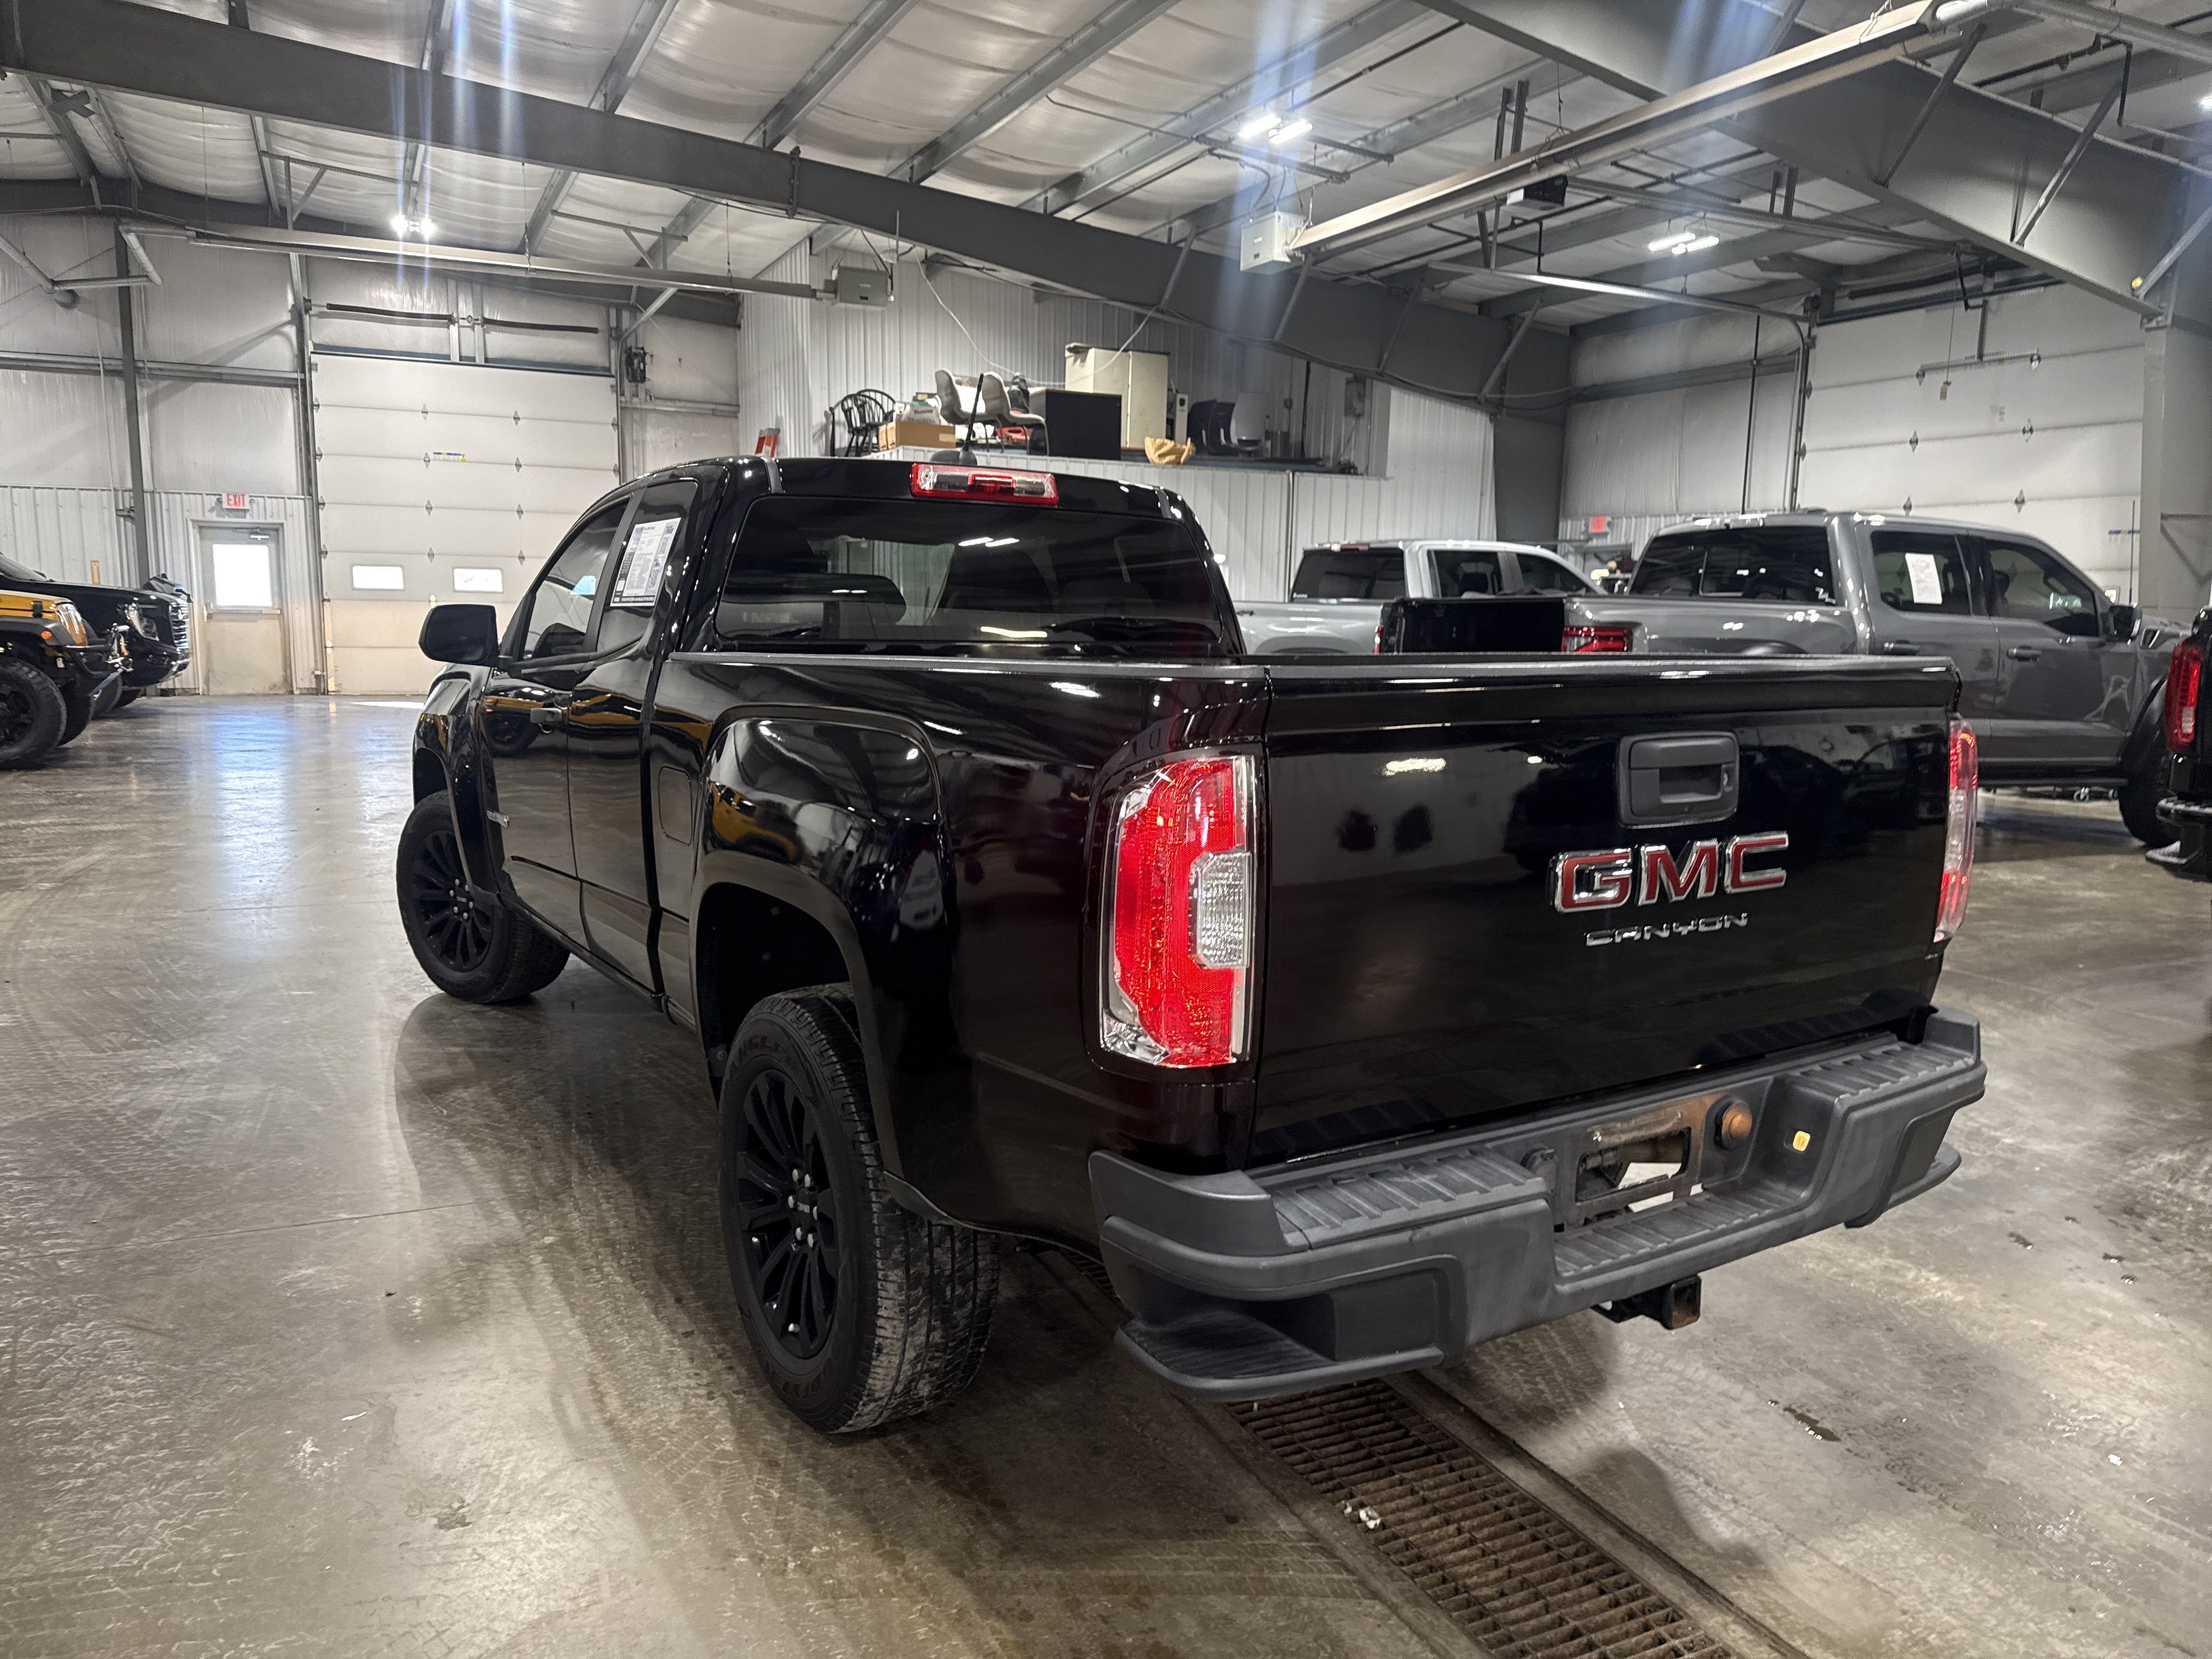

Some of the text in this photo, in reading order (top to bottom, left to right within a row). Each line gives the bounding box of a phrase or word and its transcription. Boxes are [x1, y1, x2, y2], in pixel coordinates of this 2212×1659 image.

[227, 493, 246, 507] EXIT
[1553, 831, 1789, 914] GMC
[1584, 912, 1749, 946] CANYON
